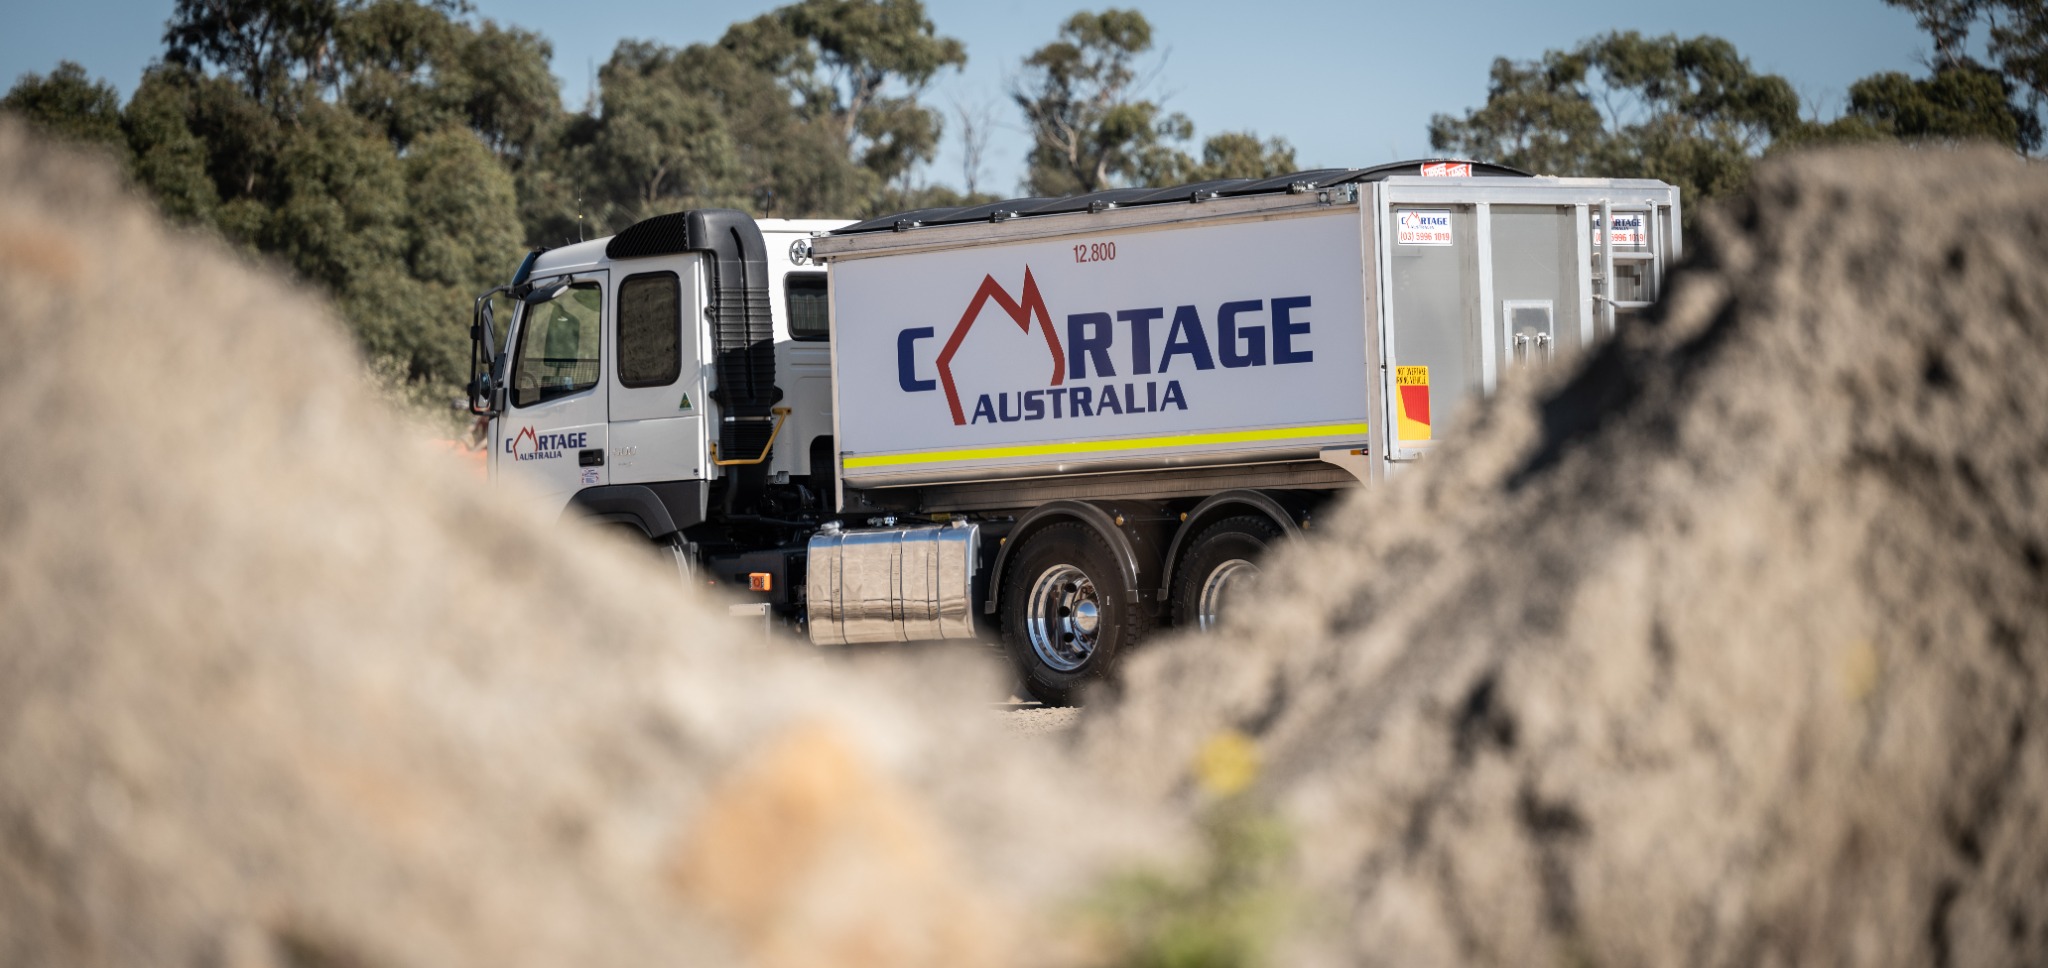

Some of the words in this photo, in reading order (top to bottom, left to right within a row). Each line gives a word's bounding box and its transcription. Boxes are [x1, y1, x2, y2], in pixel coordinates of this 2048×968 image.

[1400, 231, 1414, 241] (03)
[1416, 232, 1432, 241] 5996
[1434, 232, 1450, 241] 1019
[1073, 242, 1116, 263] 12.800
[971, 380, 1189, 425] AUSTRALIA
[519, 450, 563, 461] AUSTRALIA
